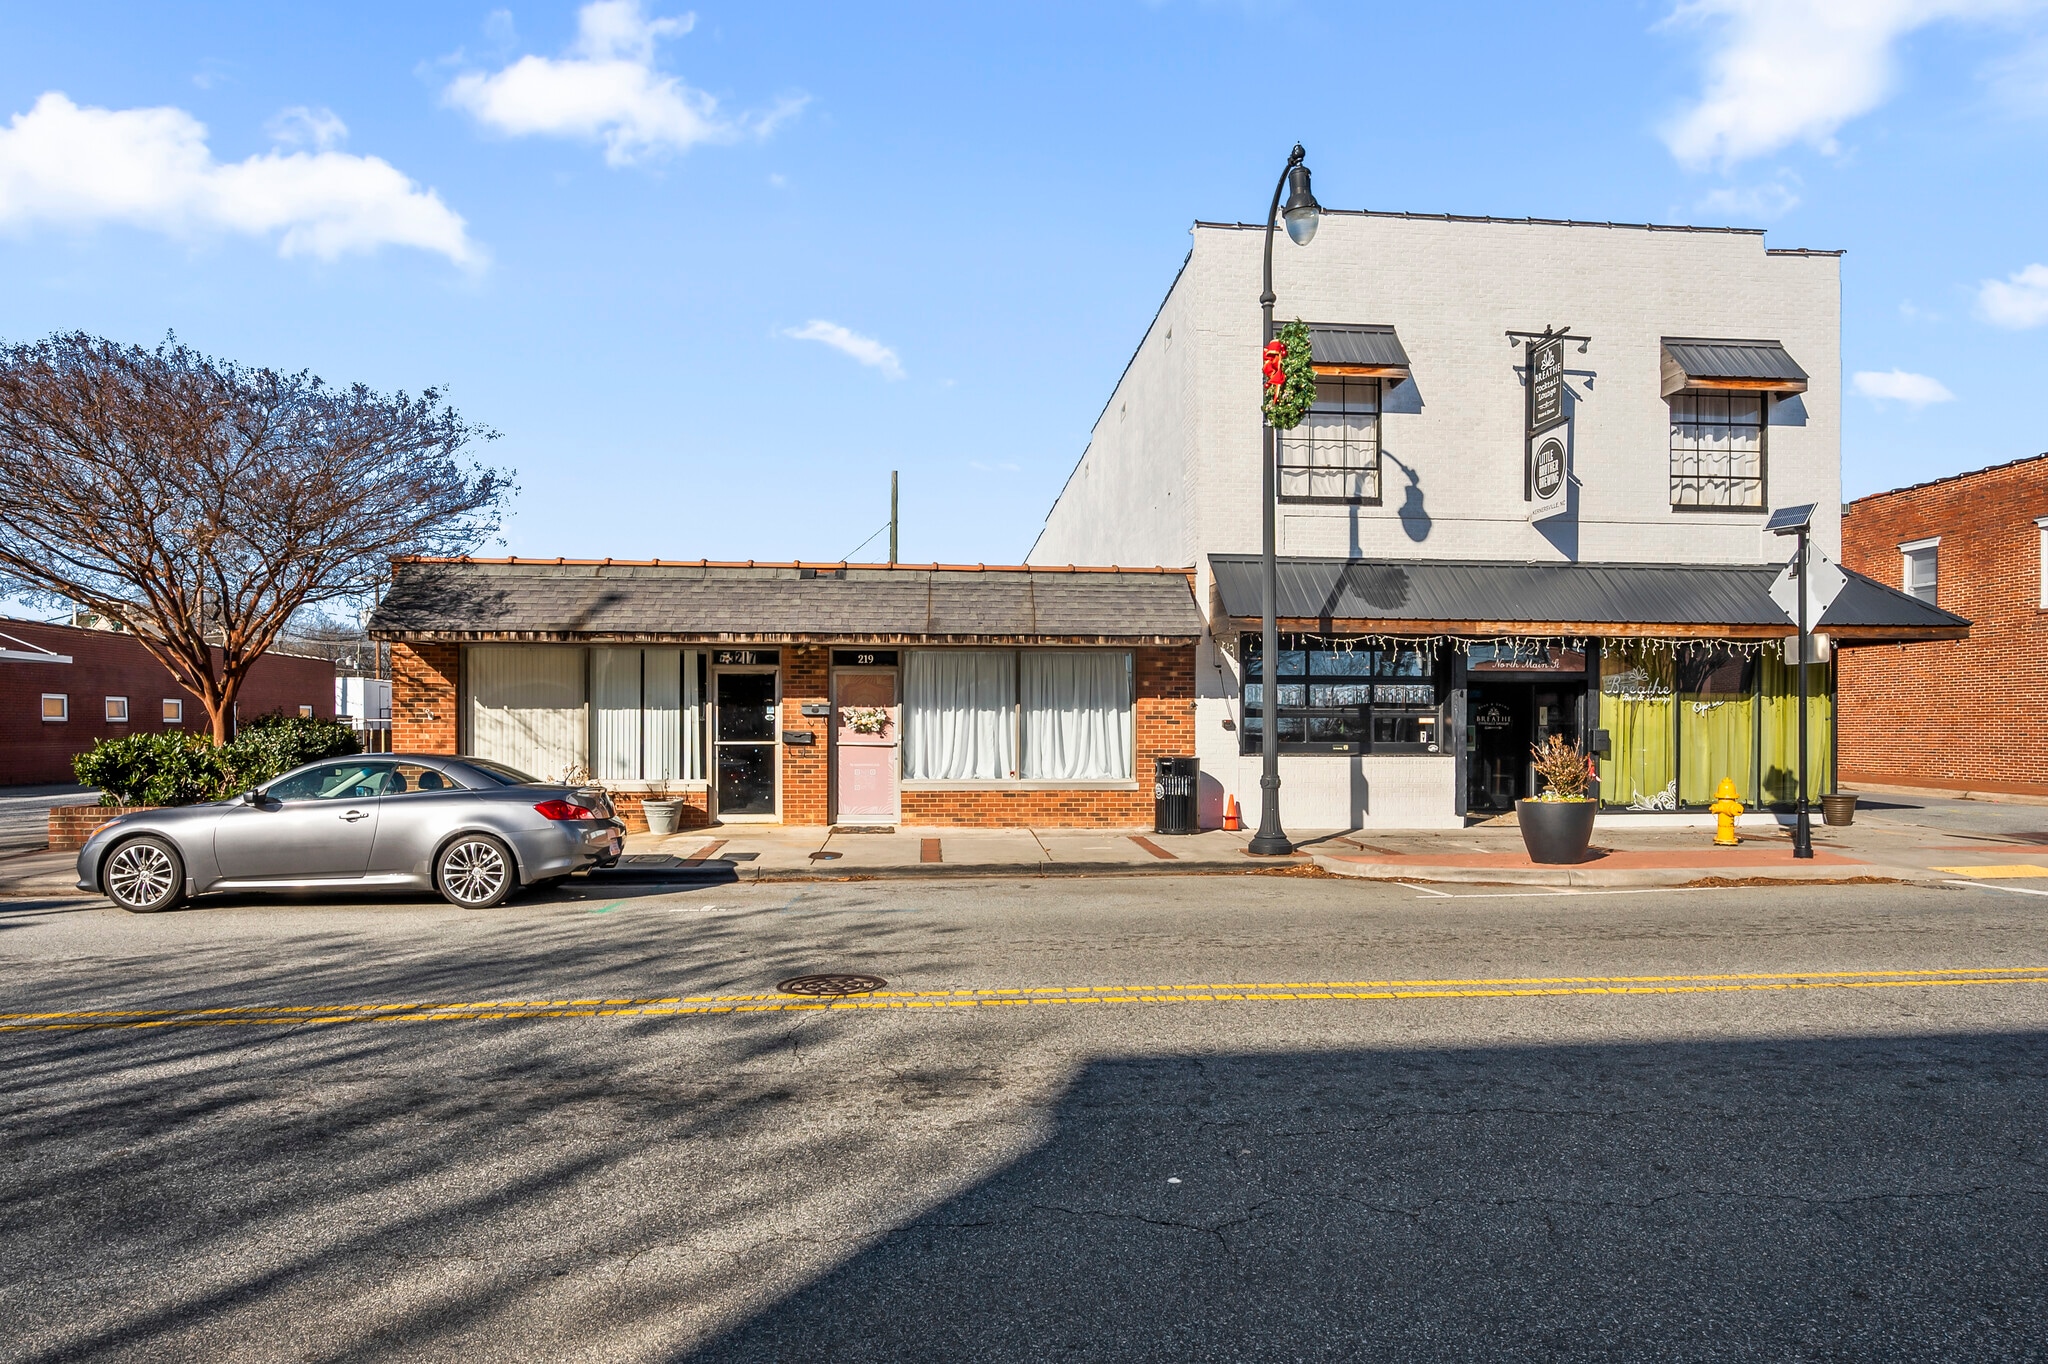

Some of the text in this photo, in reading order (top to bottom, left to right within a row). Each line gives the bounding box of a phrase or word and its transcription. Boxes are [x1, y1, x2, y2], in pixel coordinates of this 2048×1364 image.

[1535, 363, 1561, 383] BREATHE
[1536, 376, 1559, 394] Cocktail
[1538, 387, 1557, 401] Lounge
[1539, 449, 1554, 466] LITTLE
[858, 654, 874, 664] 219
[1492, 659, 1560, 669] North Main St
[1605, 676, 1671, 694] Breathe
[1622, 693, 1637, 702] Bar
[1638, 693, 1645, 701] &
[1692, 700, 1725, 718] Open
